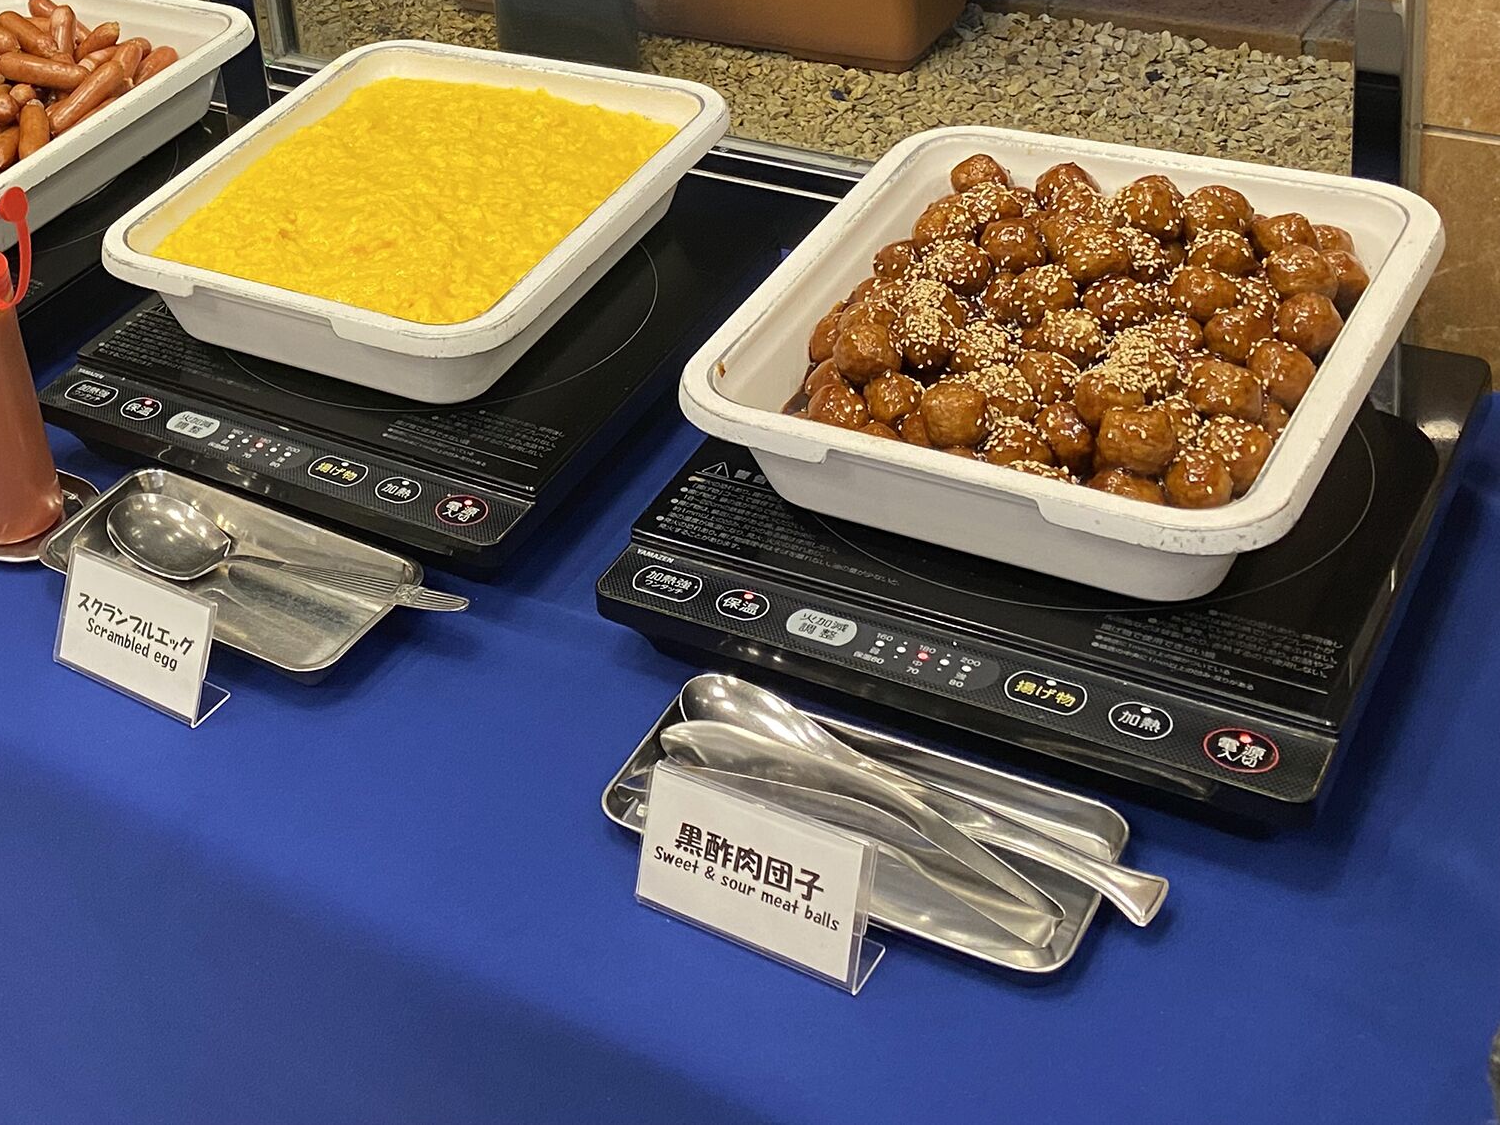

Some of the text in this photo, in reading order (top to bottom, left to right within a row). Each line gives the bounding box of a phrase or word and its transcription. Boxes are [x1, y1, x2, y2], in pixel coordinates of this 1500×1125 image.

[637, 548, 675, 564] YAMAZEN
[646, 570, 693, 590] 加熱強
[722, 596, 760, 616] 保温
[78, 592, 195, 656] スクランブルエッグ
[800, 613, 849, 633] 火加減
[86, 617, 178, 672] Scrambled egg
[877, 633, 981, 667] 160 180 200
[906, 666, 919, 675] 70
[948, 679, 964, 688] 80
[1015, 679, 1076, 708] 揚げ物
[1118, 710, 1162, 734] 加熱
[674, 821, 824, 902] 黒酢肉団子
[654, 845, 840, 932] Sweet & sour meat balls
